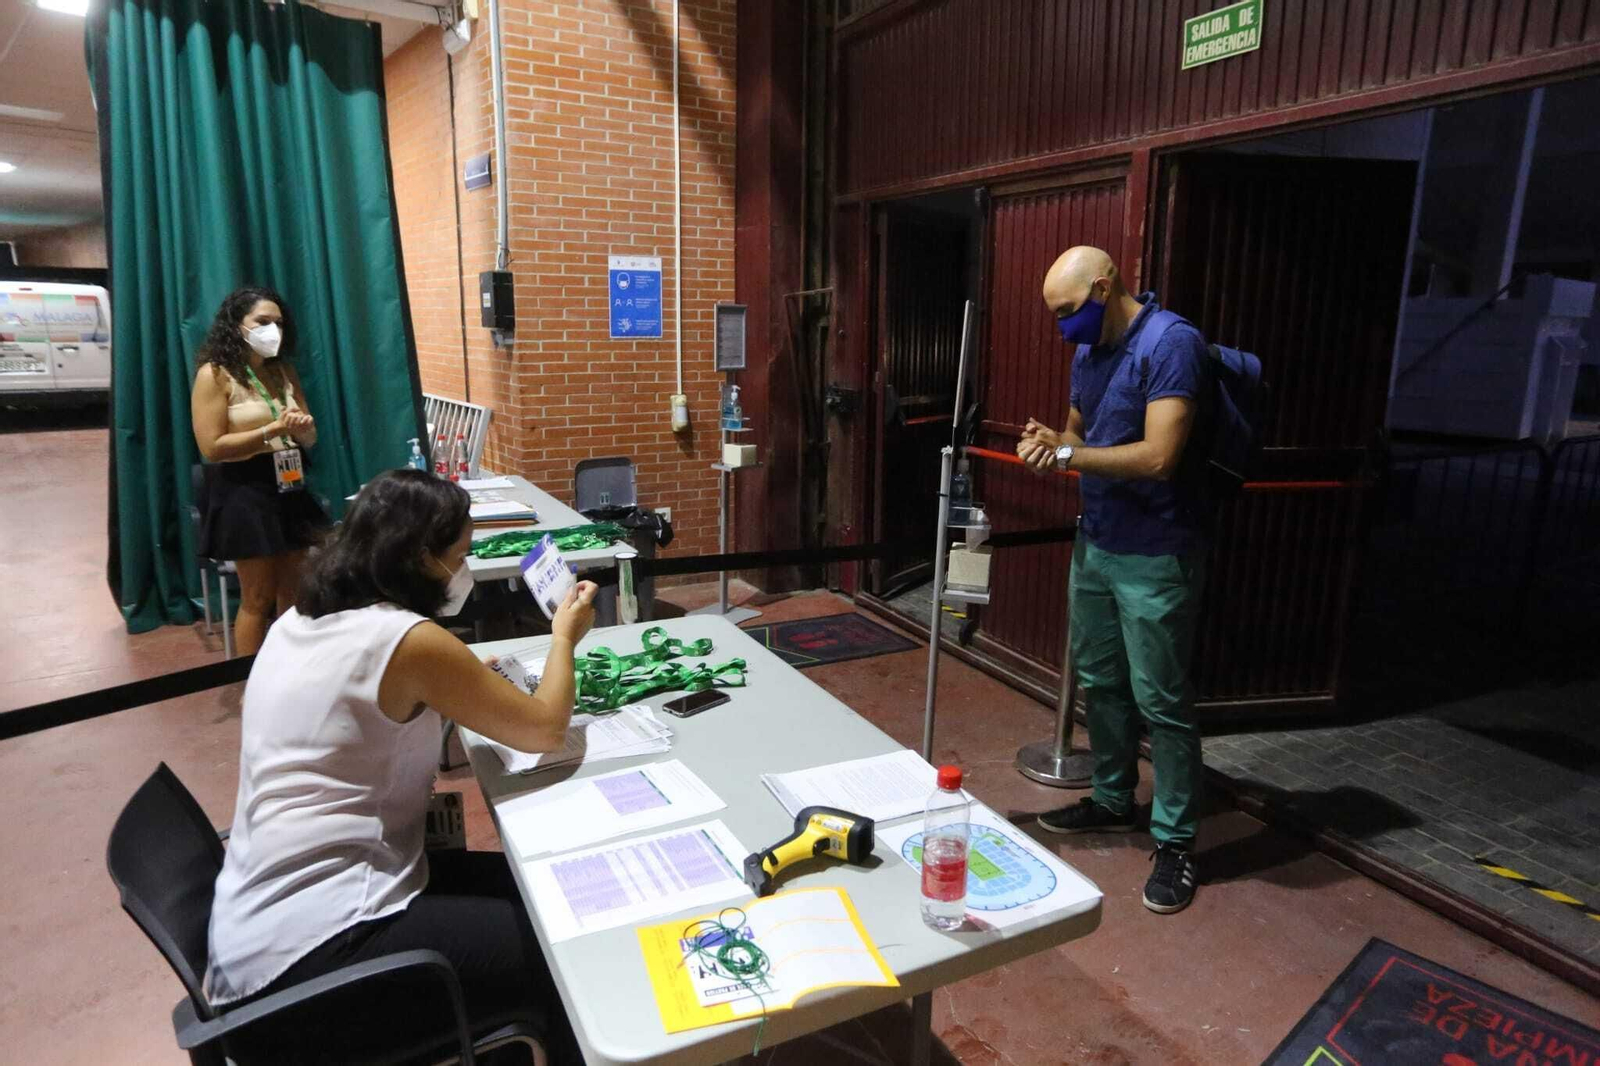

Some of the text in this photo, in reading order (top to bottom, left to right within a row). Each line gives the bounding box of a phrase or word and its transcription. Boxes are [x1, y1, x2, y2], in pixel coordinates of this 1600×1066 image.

[1191, 6, 1255, 42] SALIDA DE
[1185, 28, 1257, 64] EMERGENCIA
[1405, 999, 1470, 1042] DE
